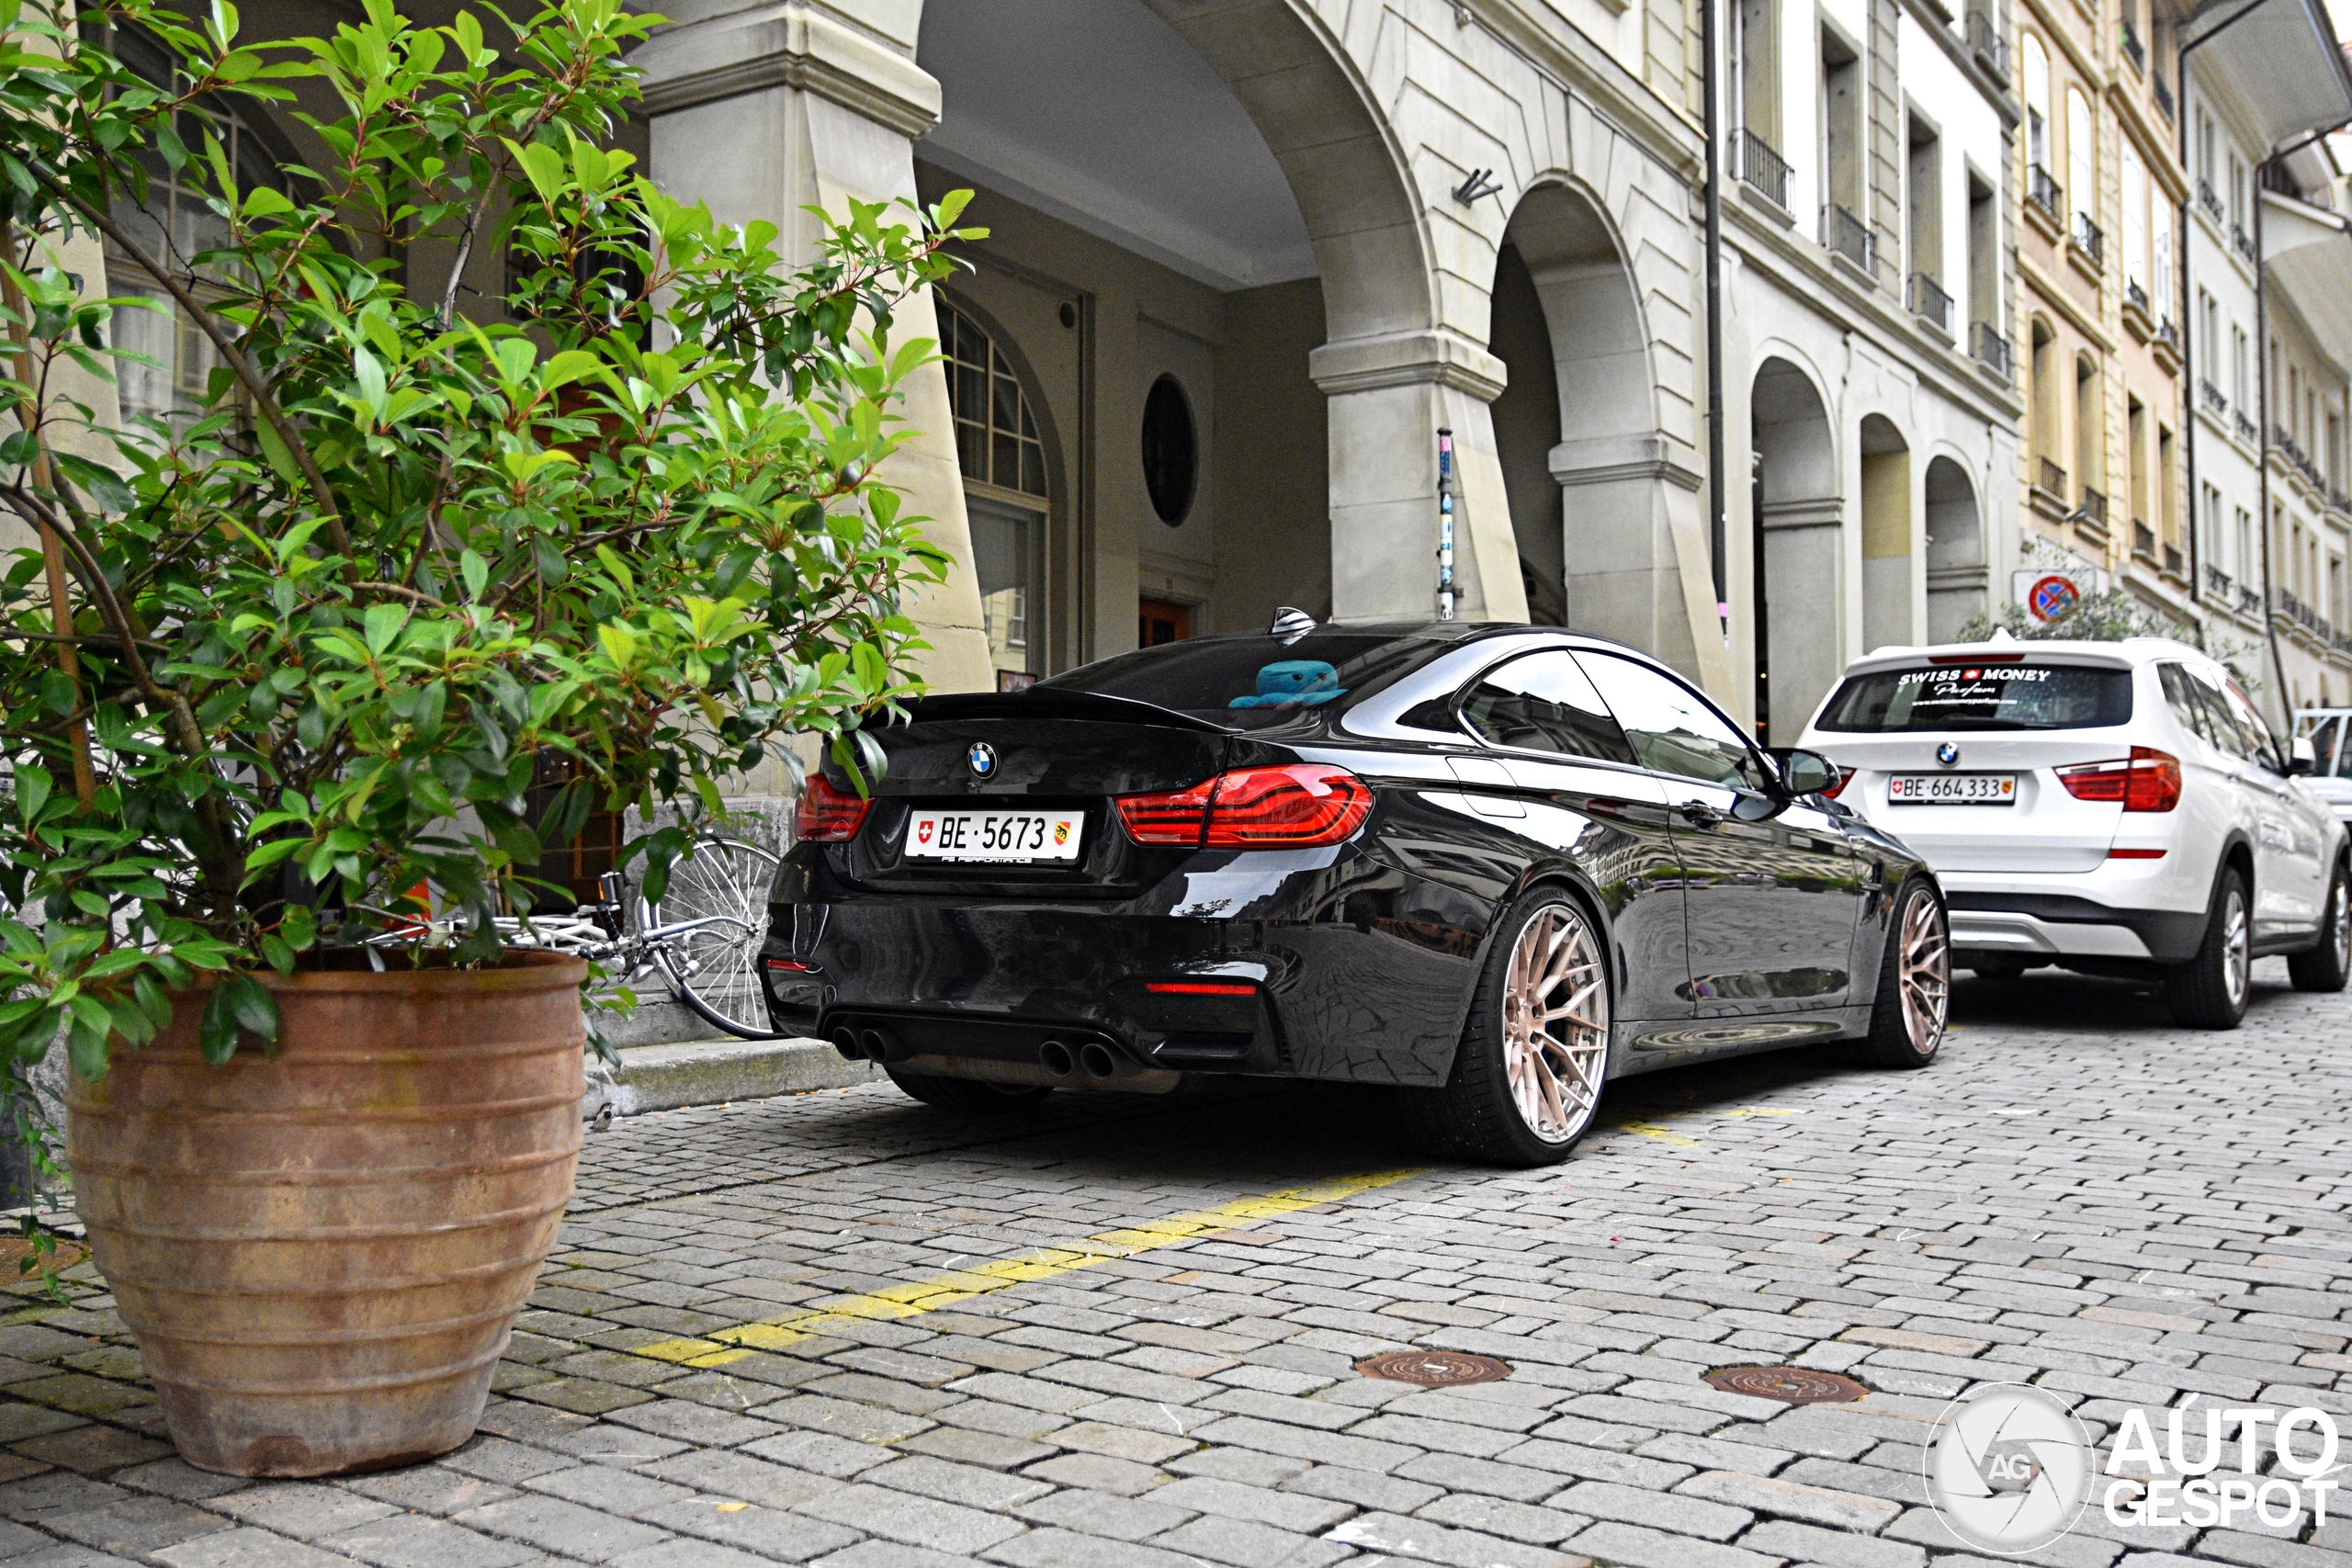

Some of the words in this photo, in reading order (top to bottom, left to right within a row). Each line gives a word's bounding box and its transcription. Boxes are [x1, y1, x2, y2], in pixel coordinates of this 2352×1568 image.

[1898, 670, 1961, 685] SWISS
[1982, 669, 2051, 682] MONEY
[1934, 682, 1996, 697] Parfum
[968, 743, 993, 756] BMW
